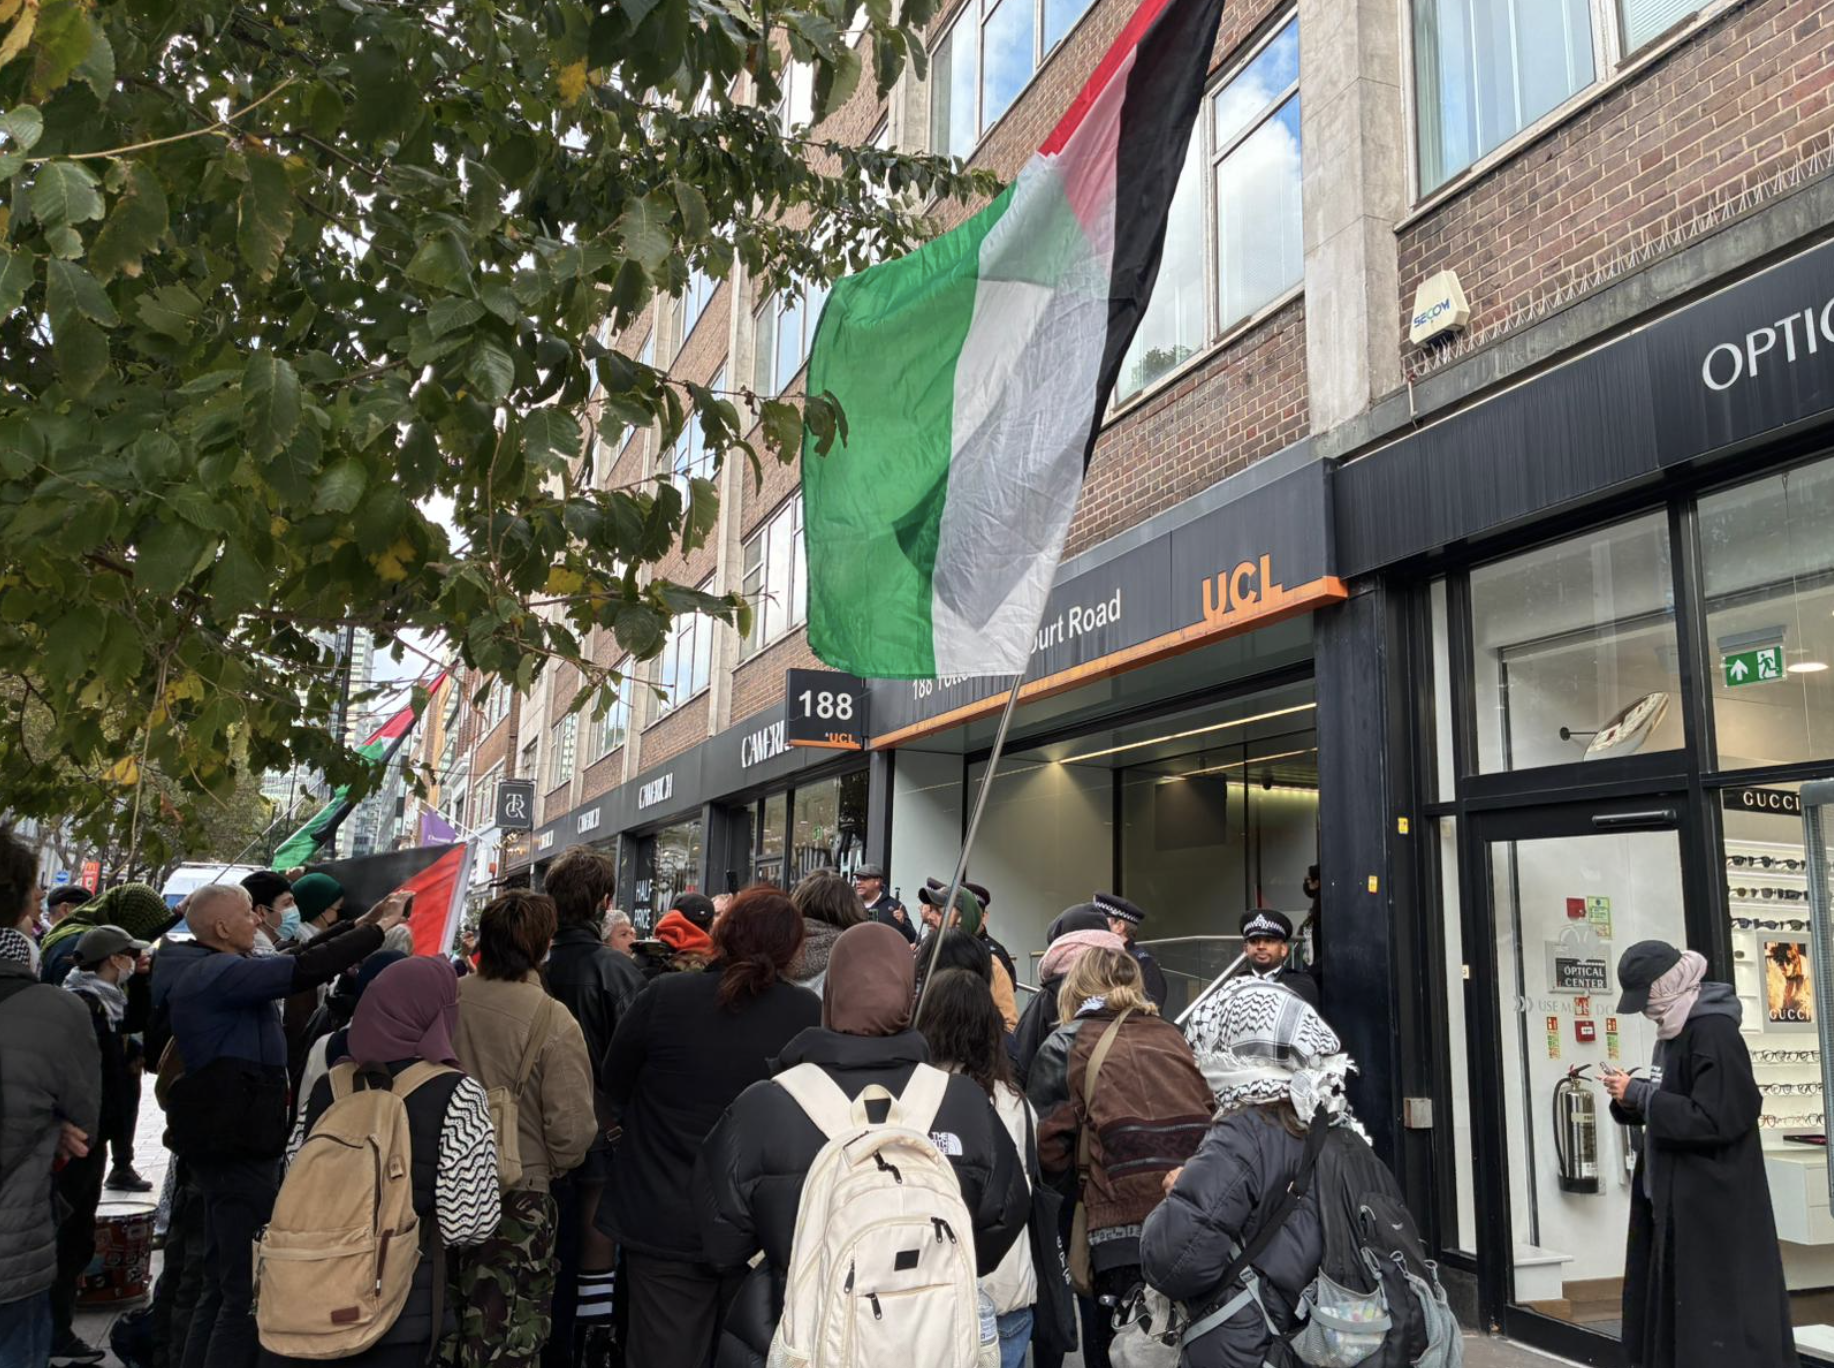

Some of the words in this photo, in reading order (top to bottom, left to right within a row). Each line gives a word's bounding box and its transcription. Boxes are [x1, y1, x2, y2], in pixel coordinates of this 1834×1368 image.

[1413, 298, 1450, 328] SECOM
[1202, 553, 1283, 622] UCL
[1069, 588, 1121, 638] Road
[798, 690, 853, 720] 188
[741, 720, 794, 768] CAMERI
[829, 732, 859, 747] UCL
[1743, 791, 1800, 811] GUCCI
[1563, 965, 1605, 978] OPTICAL
[1564, 978, 1605, 989] CENTER
[1768, 1008, 1810, 1020] GUCCI
